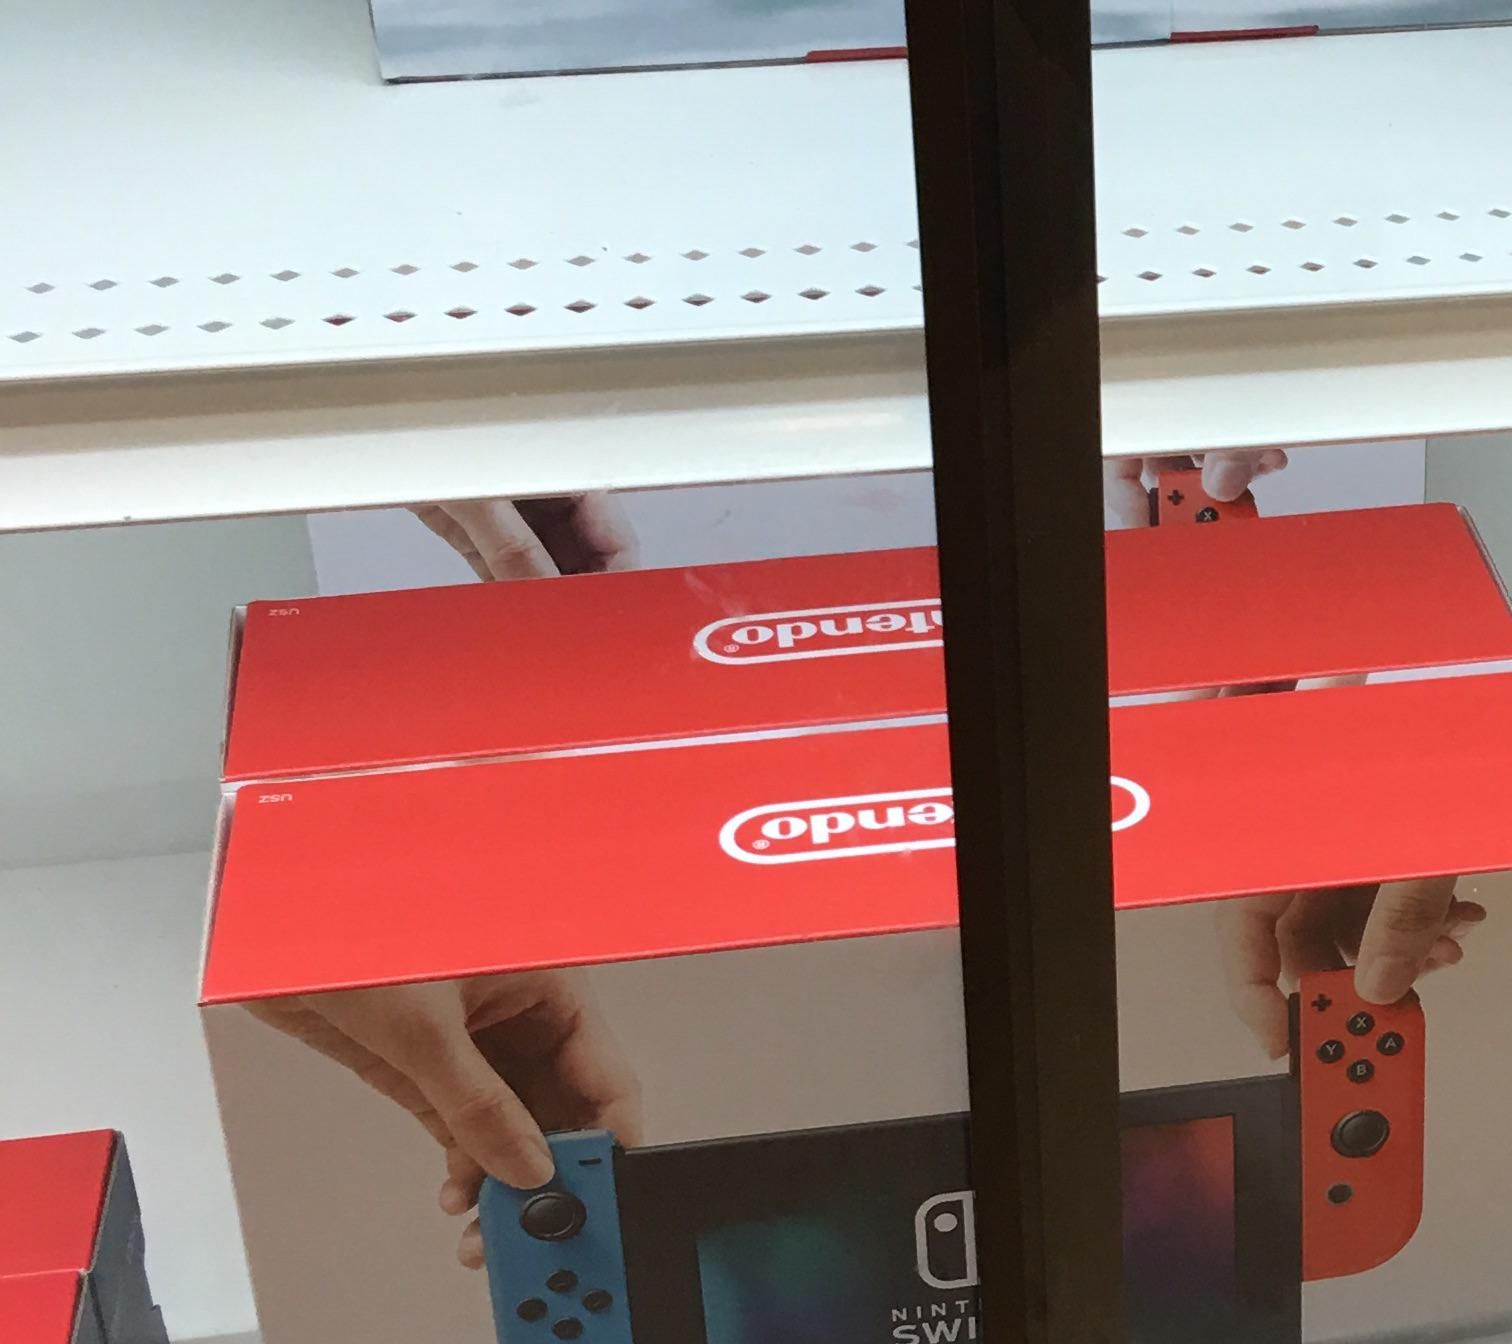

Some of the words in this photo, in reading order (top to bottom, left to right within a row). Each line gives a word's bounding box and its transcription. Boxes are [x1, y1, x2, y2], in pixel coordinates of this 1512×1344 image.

[1203, 511, 1213, 522] X
[732, 610, 943, 648] tendo
[761, 802, 954, 844] endo
[1356, 1017, 1367, 1028] X
[1385, 1037, 1397, 1049] A
[1326, 1044, 1337, 1055] Y
[1357, 1064, 1366, 1076] B
[891, 1299, 970, 1322] NINT
